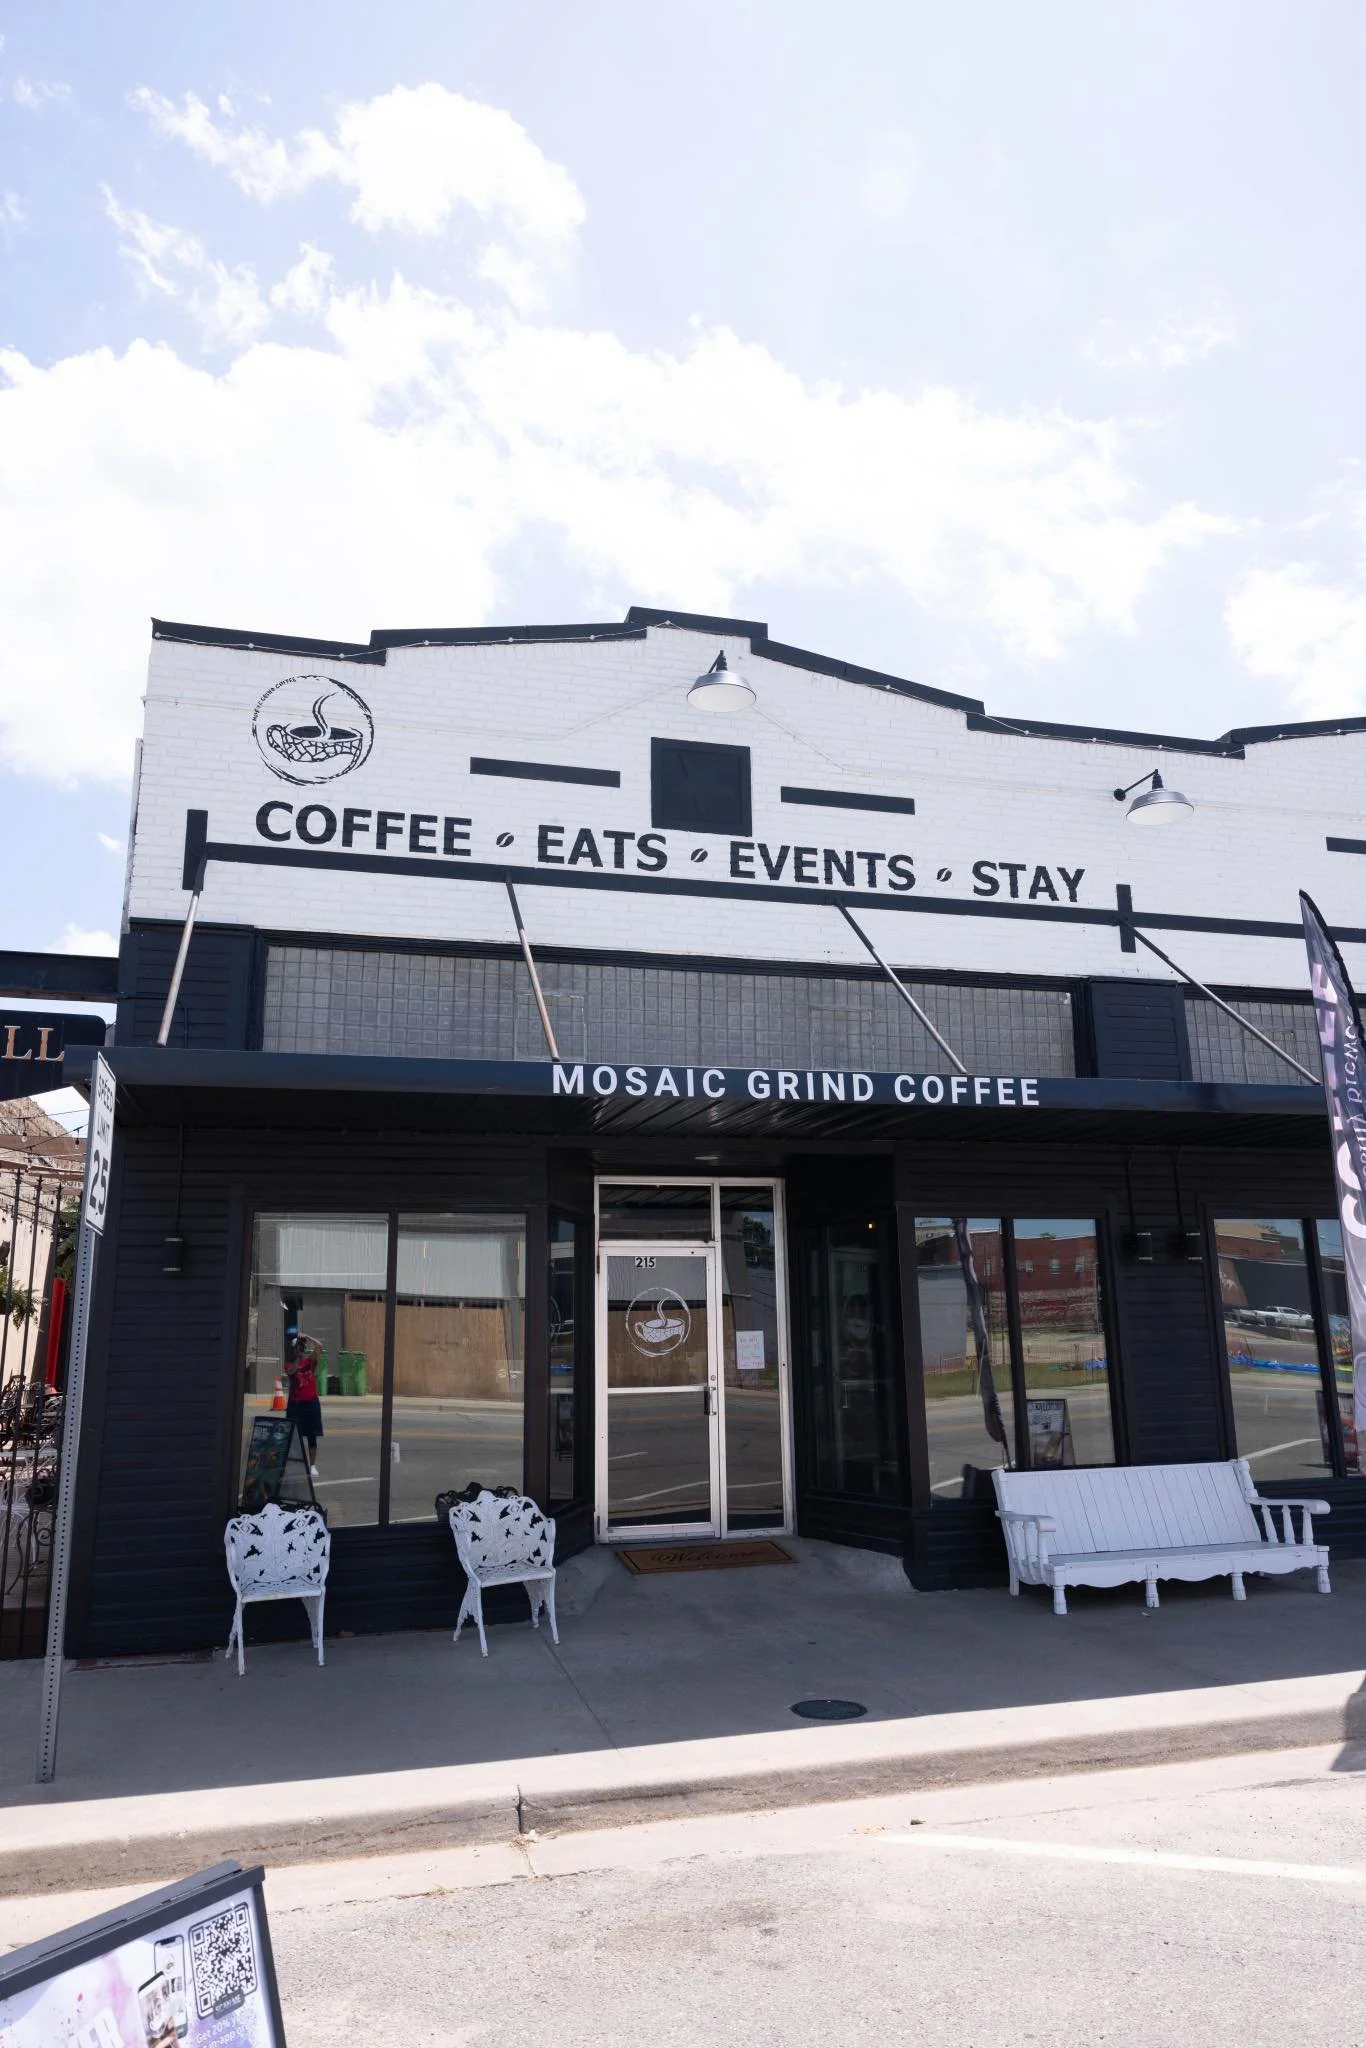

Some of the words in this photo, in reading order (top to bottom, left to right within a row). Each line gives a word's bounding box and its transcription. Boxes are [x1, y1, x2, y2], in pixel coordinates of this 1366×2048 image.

[255, 800, 473, 857] COFFEE
[537, 824, 668, 872] EATS
[730, 840, 916, 891] EVENTS
[972, 860, 1086, 902] STAY
[97, 1073, 114, 1113] SPEED
[551, 1063, 727, 1099] MOSAIC
[747, 1069, 875, 1103] GRIND
[894, 1075, 1040, 1106] COFFEE
[97, 1112, 110, 1145] LIMIT
[89, 1148, 109, 1216] 25
[636, 1257, 655, 1268] 215
[211, 2018, 231, 2036] 20%
